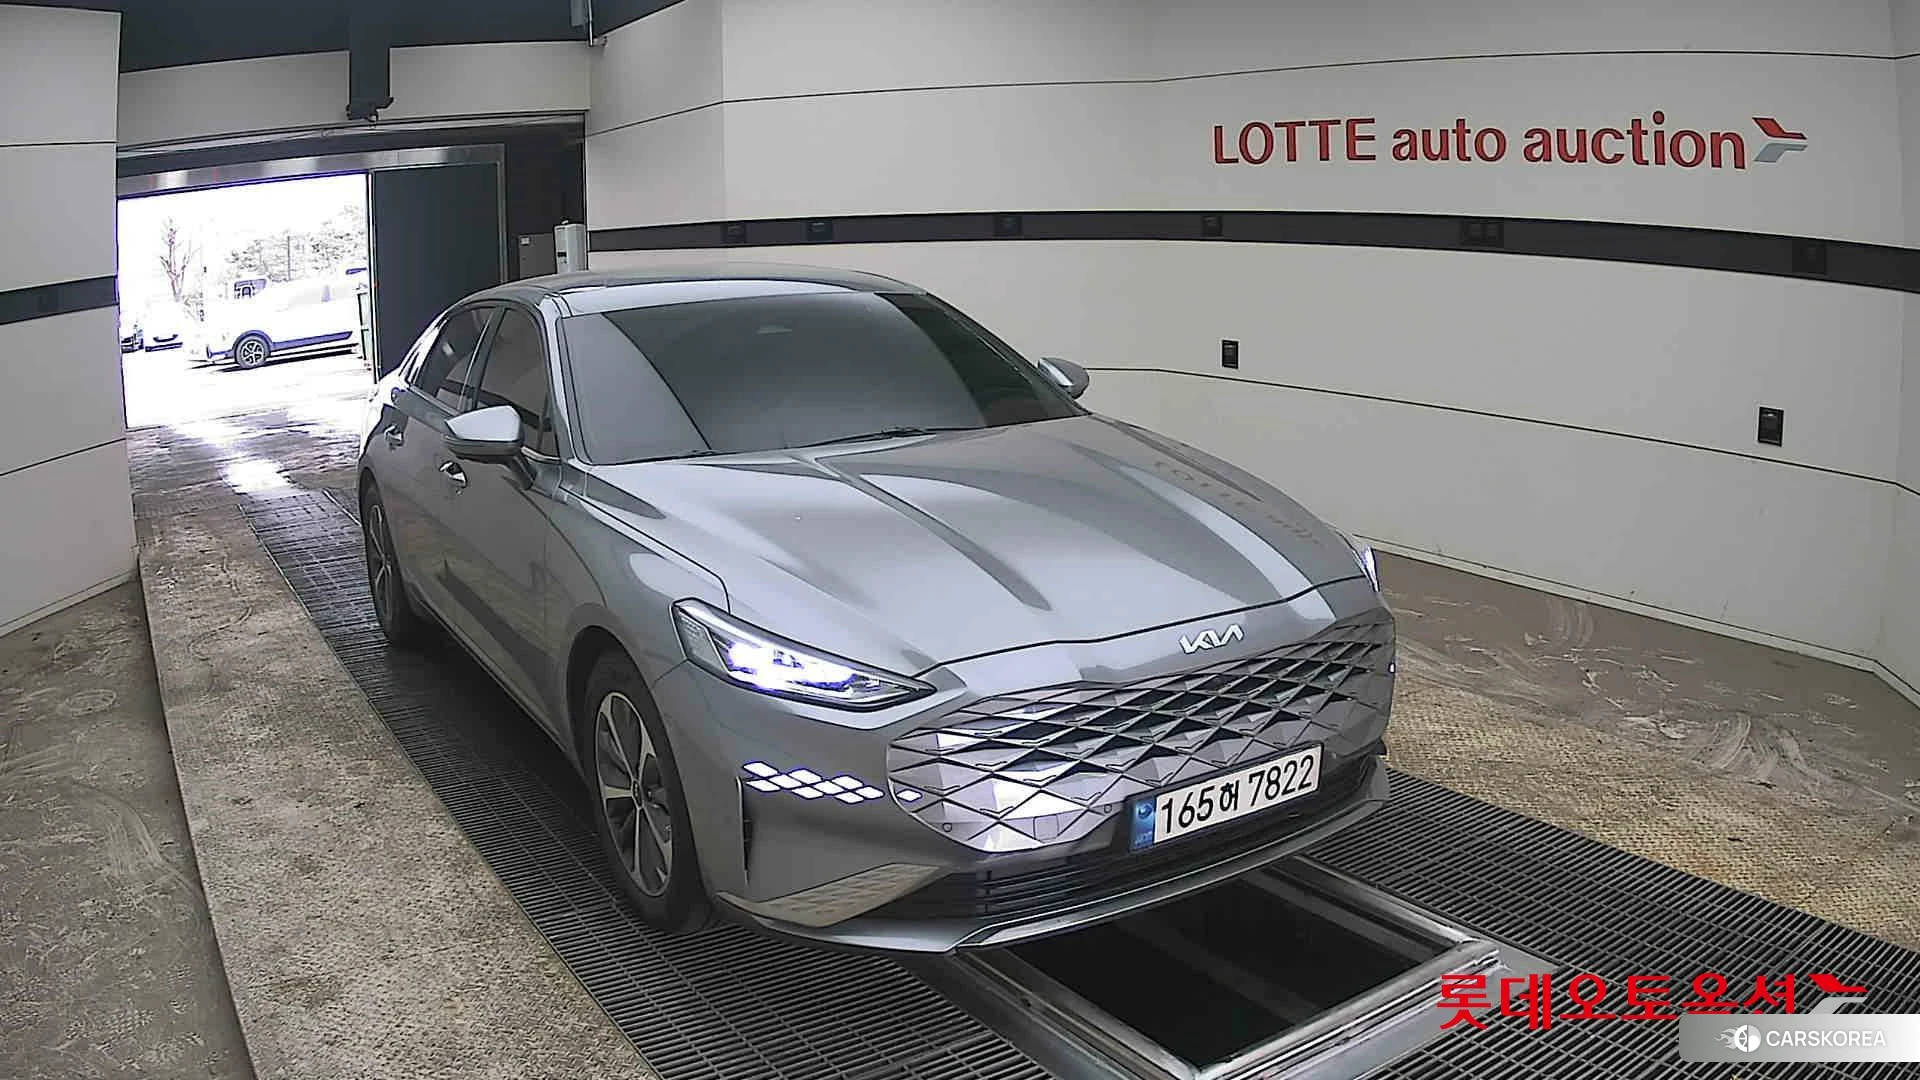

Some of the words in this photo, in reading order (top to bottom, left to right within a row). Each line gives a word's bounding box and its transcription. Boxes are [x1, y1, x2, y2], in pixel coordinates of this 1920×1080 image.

[1213, 117, 1377, 165] LOTTE
[1392, 118, 1507, 162] auto
[1523, 110, 1746, 170] auction
[1179, 623, 1244, 654] KIA
[1161, 779, 1240, 834] 165허
[1248, 754, 1314, 807] 7822
